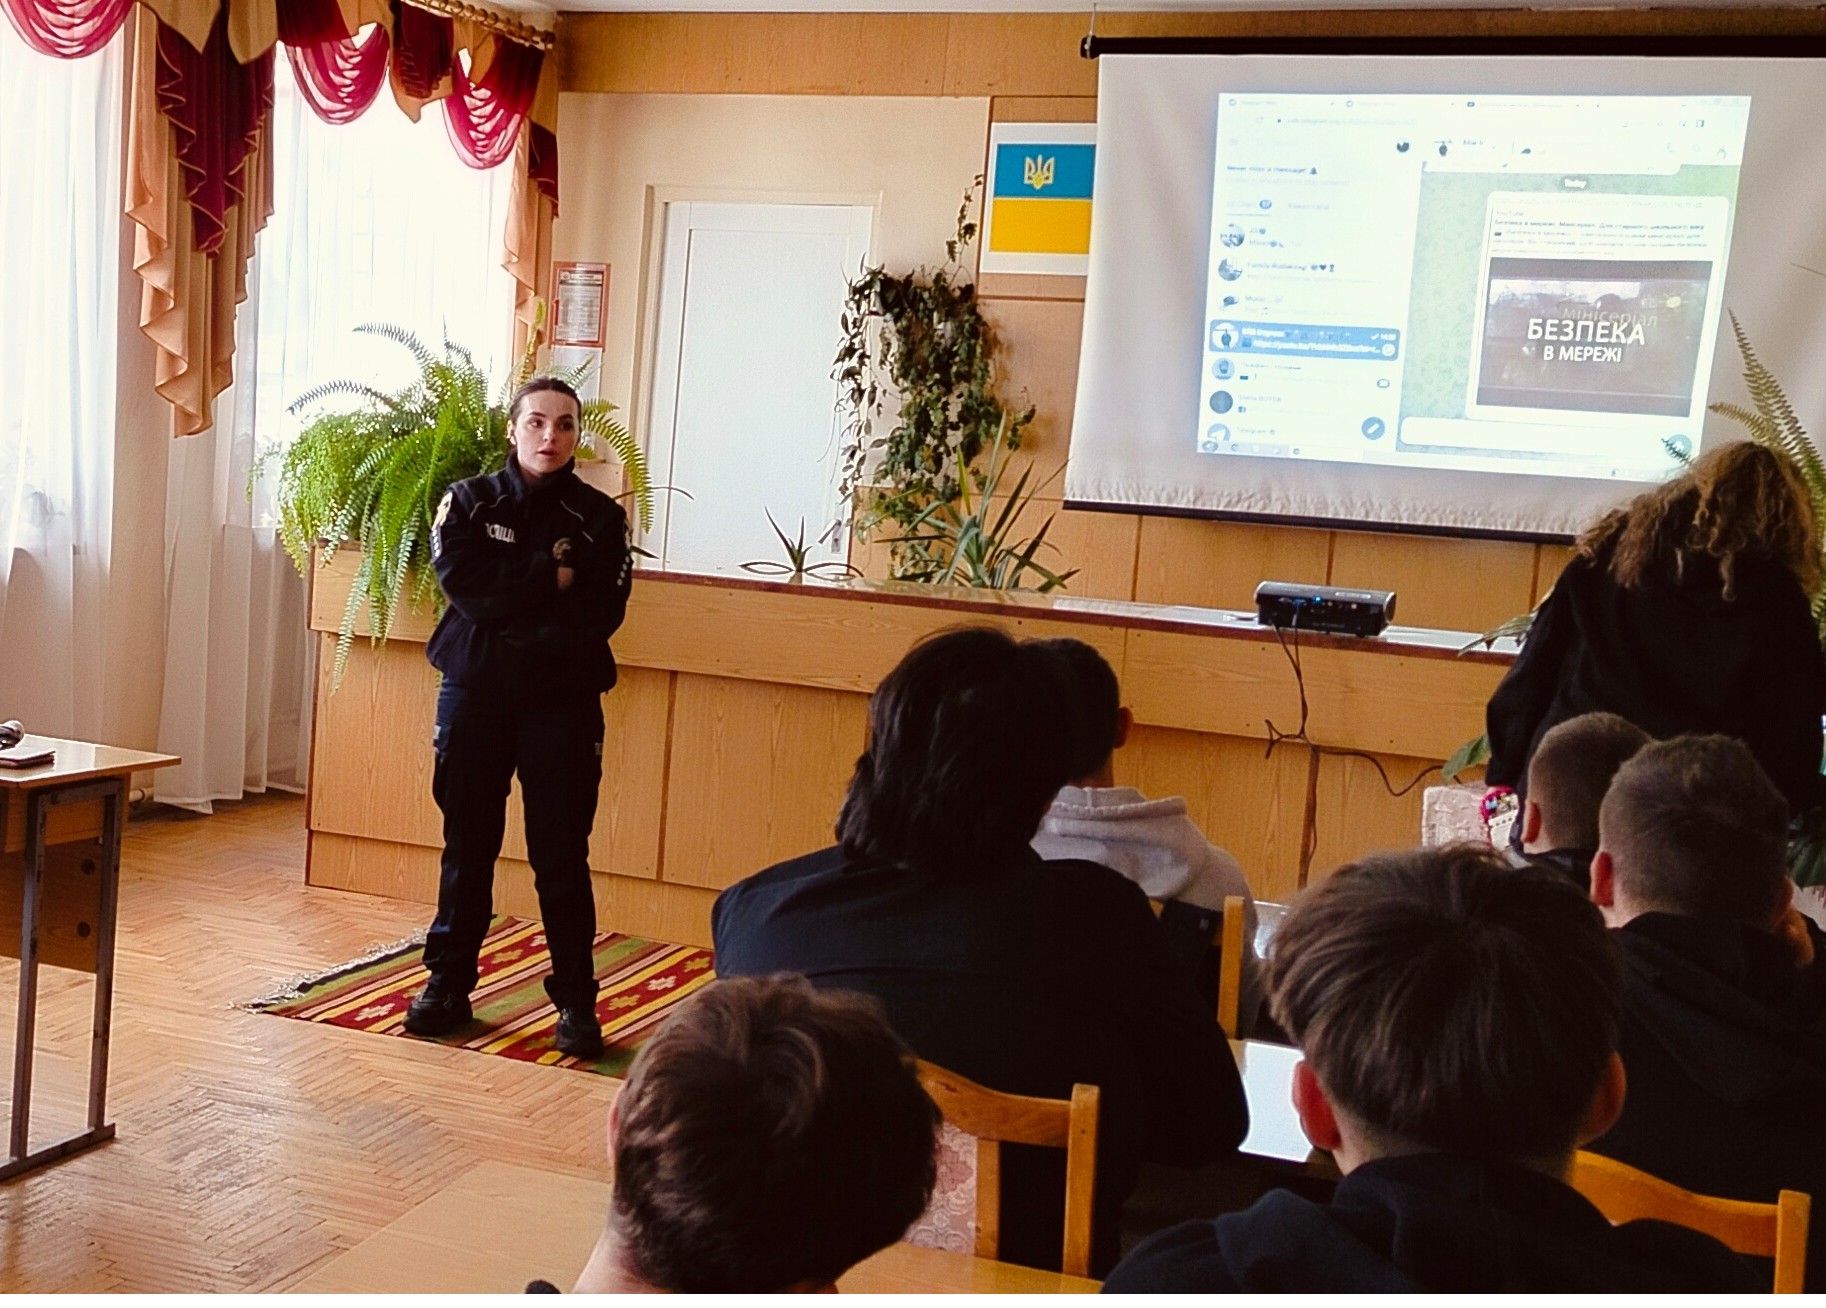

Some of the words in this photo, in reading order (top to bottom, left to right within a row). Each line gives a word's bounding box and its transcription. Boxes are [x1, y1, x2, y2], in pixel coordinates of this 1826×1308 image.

[1527, 318, 1646, 346] БЕЗПЕКА
[1543, 345, 1554, 361] В
[1558, 345, 1622, 363] МЕРЕЖІ
